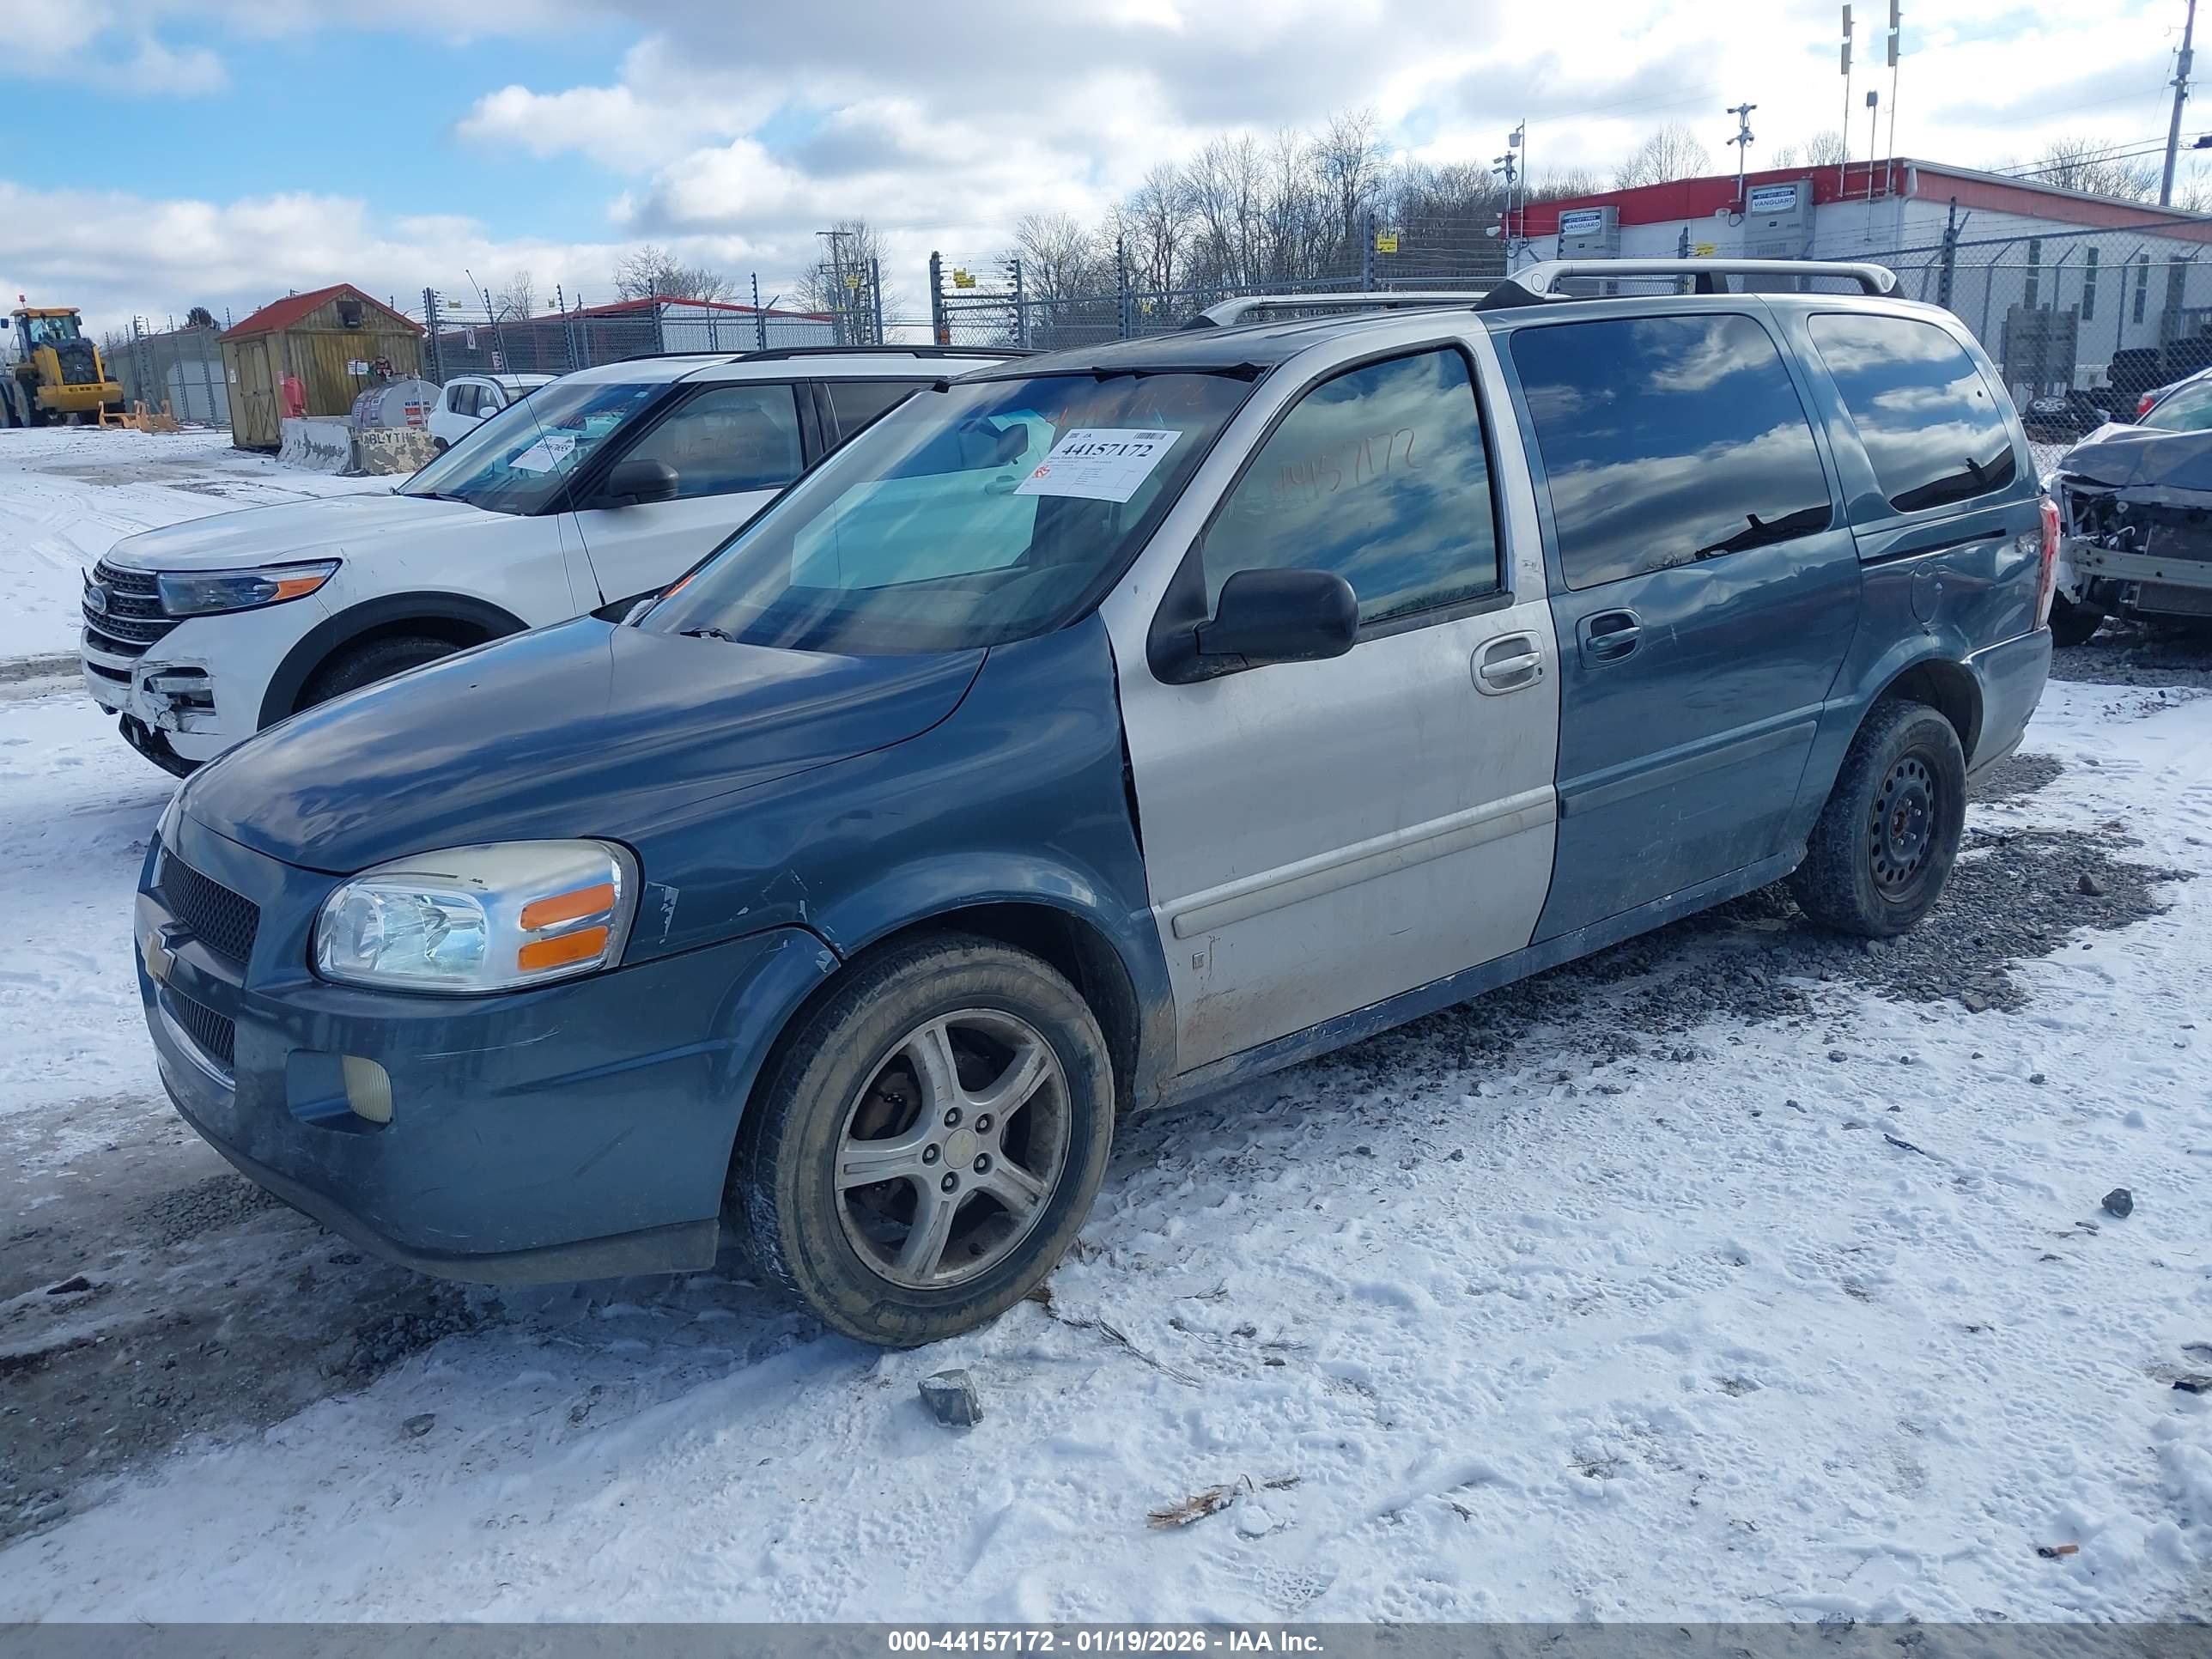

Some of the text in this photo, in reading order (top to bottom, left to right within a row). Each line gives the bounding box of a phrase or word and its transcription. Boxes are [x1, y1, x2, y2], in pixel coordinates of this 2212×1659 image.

[1754, 198, 1795, 207] VANGUARD
[1565, 221, 1600, 229] VANGUARD
[1061, 442, 1154, 458] 44157172
